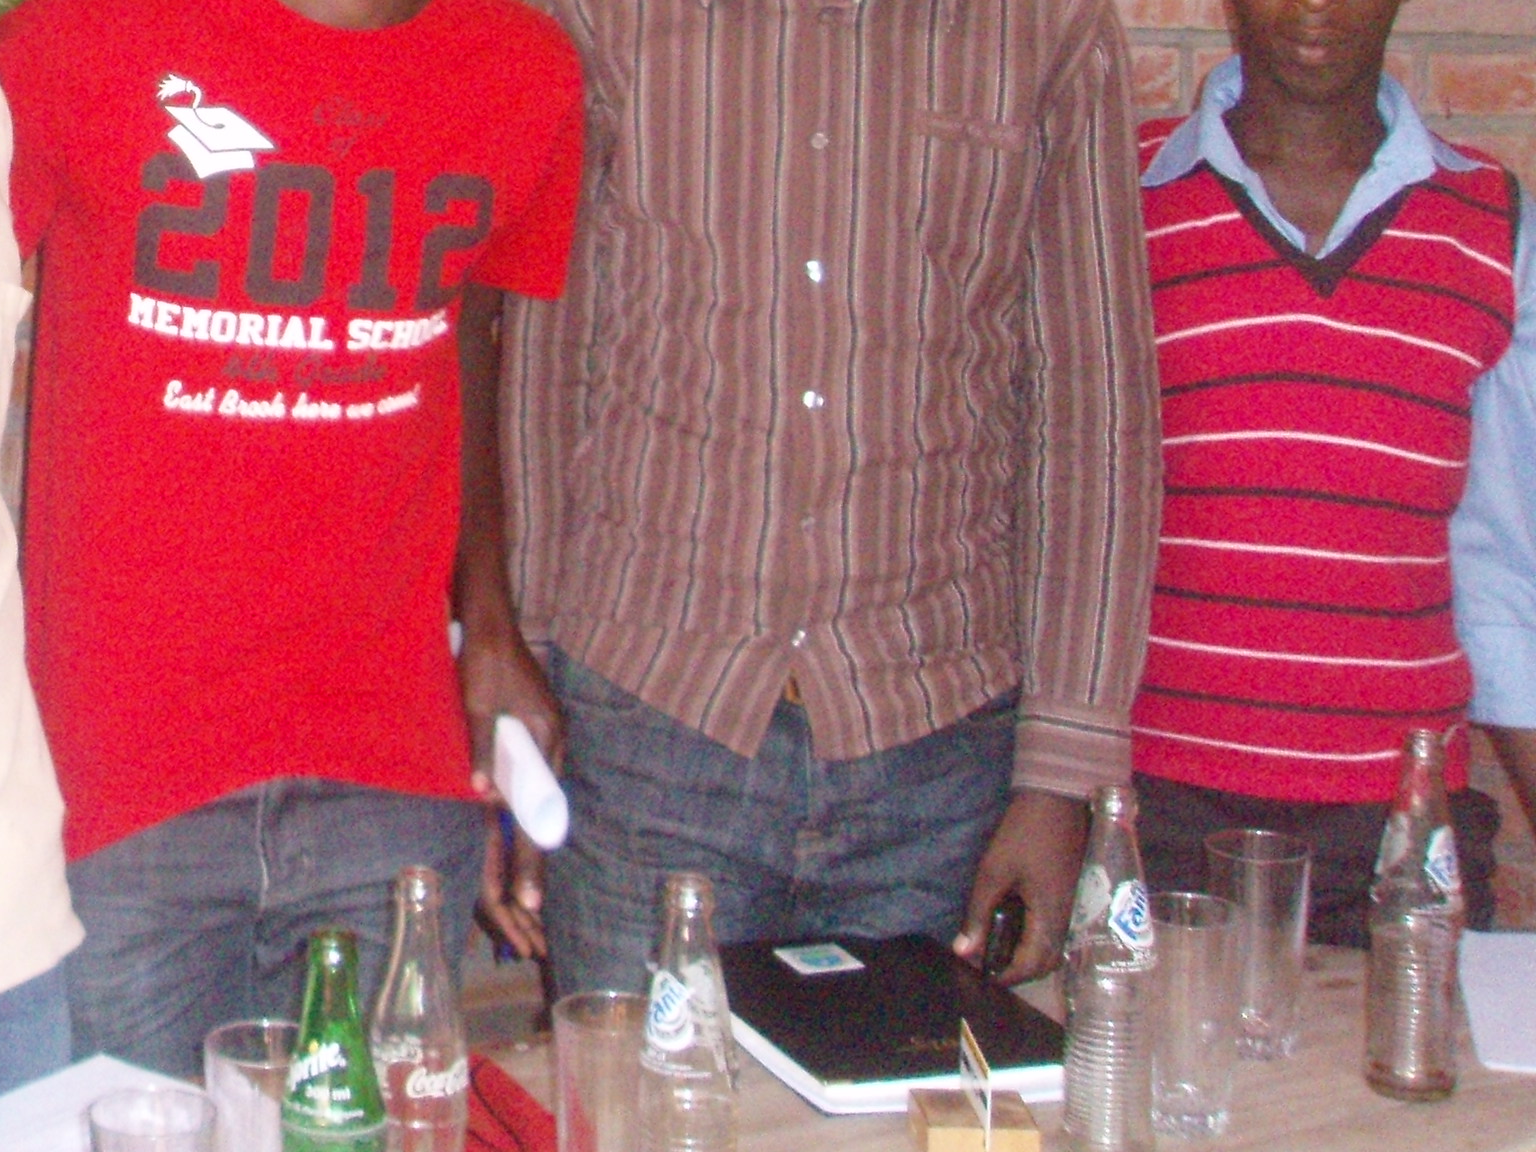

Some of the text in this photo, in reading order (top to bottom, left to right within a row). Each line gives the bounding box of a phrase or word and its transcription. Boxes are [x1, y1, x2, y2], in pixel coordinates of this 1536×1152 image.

[132, 150, 496, 312] 2012
[127, 292, 335, 351] MEMORIAL
[163, 379, 215, 413] East
